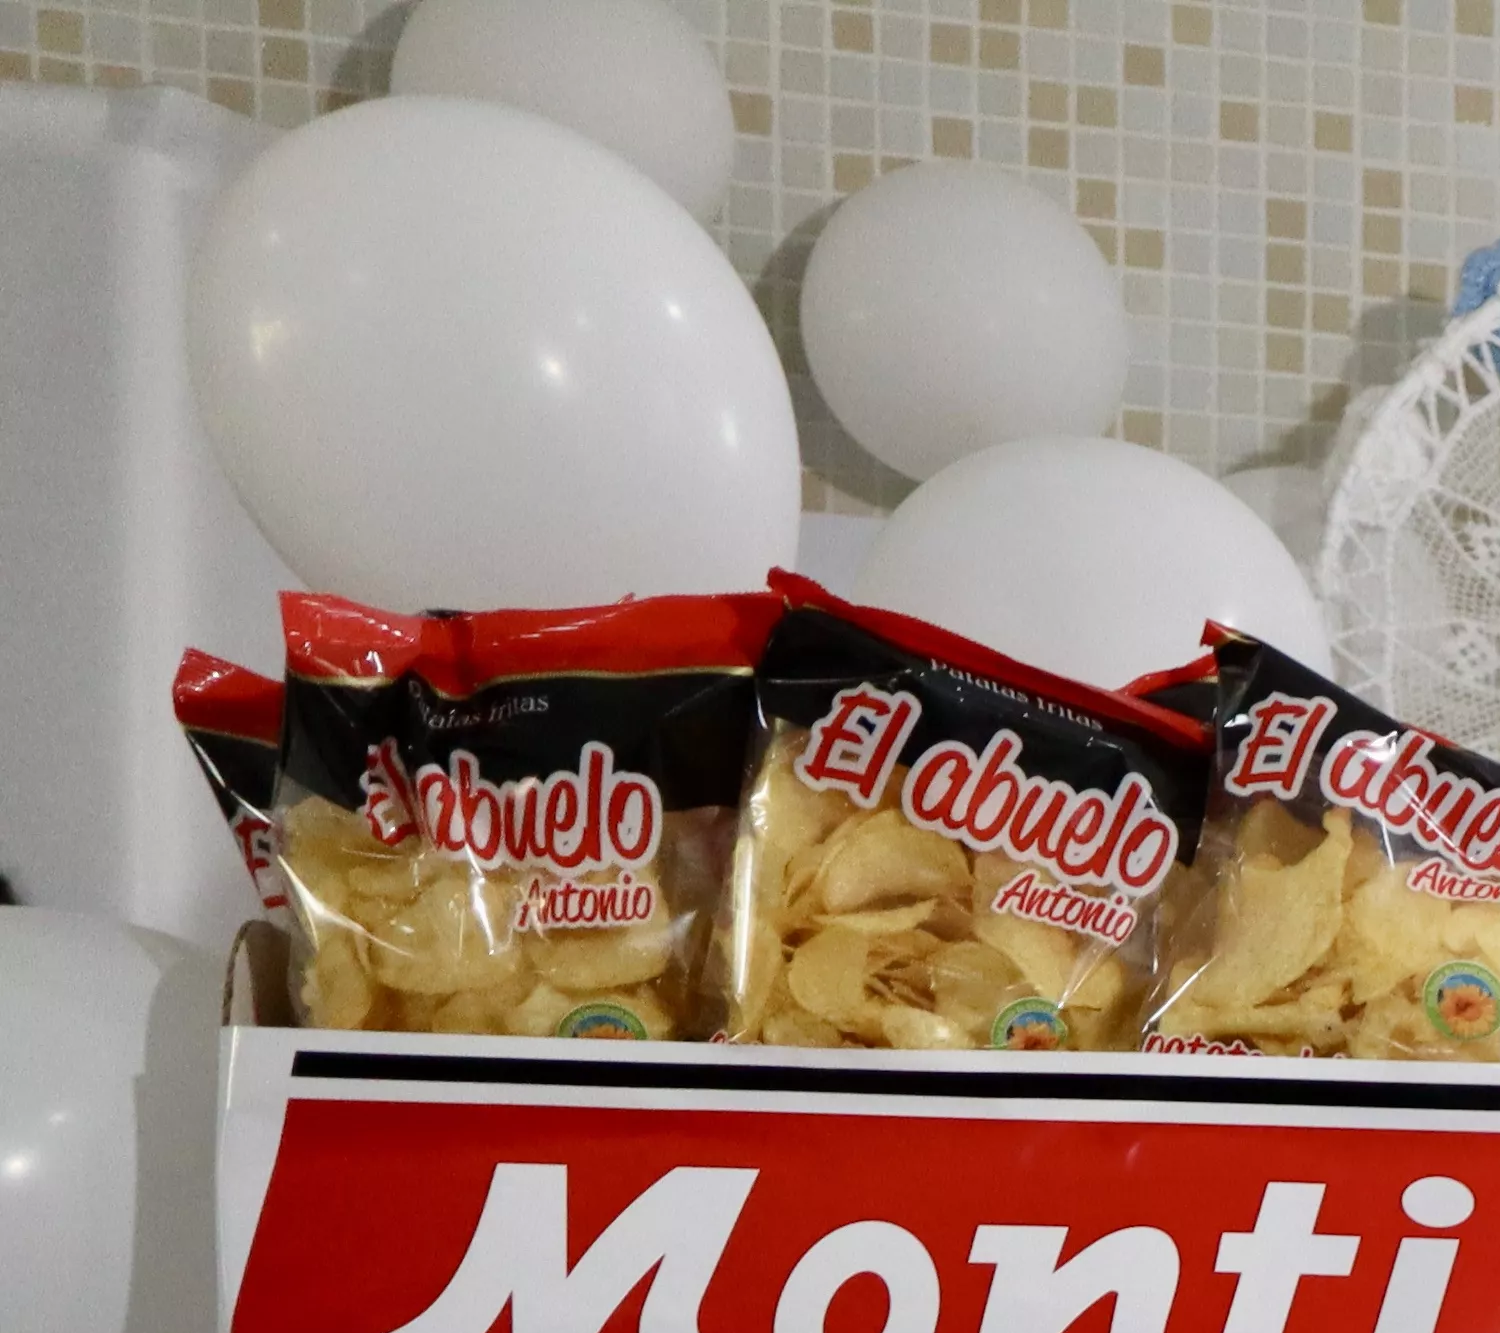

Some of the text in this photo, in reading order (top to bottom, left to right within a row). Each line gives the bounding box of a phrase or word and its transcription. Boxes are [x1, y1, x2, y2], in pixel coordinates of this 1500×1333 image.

[797, 682, 1180, 895] El abuelo
[1224, 694, 1336, 799] El
[417, 741, 662, 872] abuelo
[516, 873, 655, 930] Antonio
[992, 870, 1138, 945] Antonio
